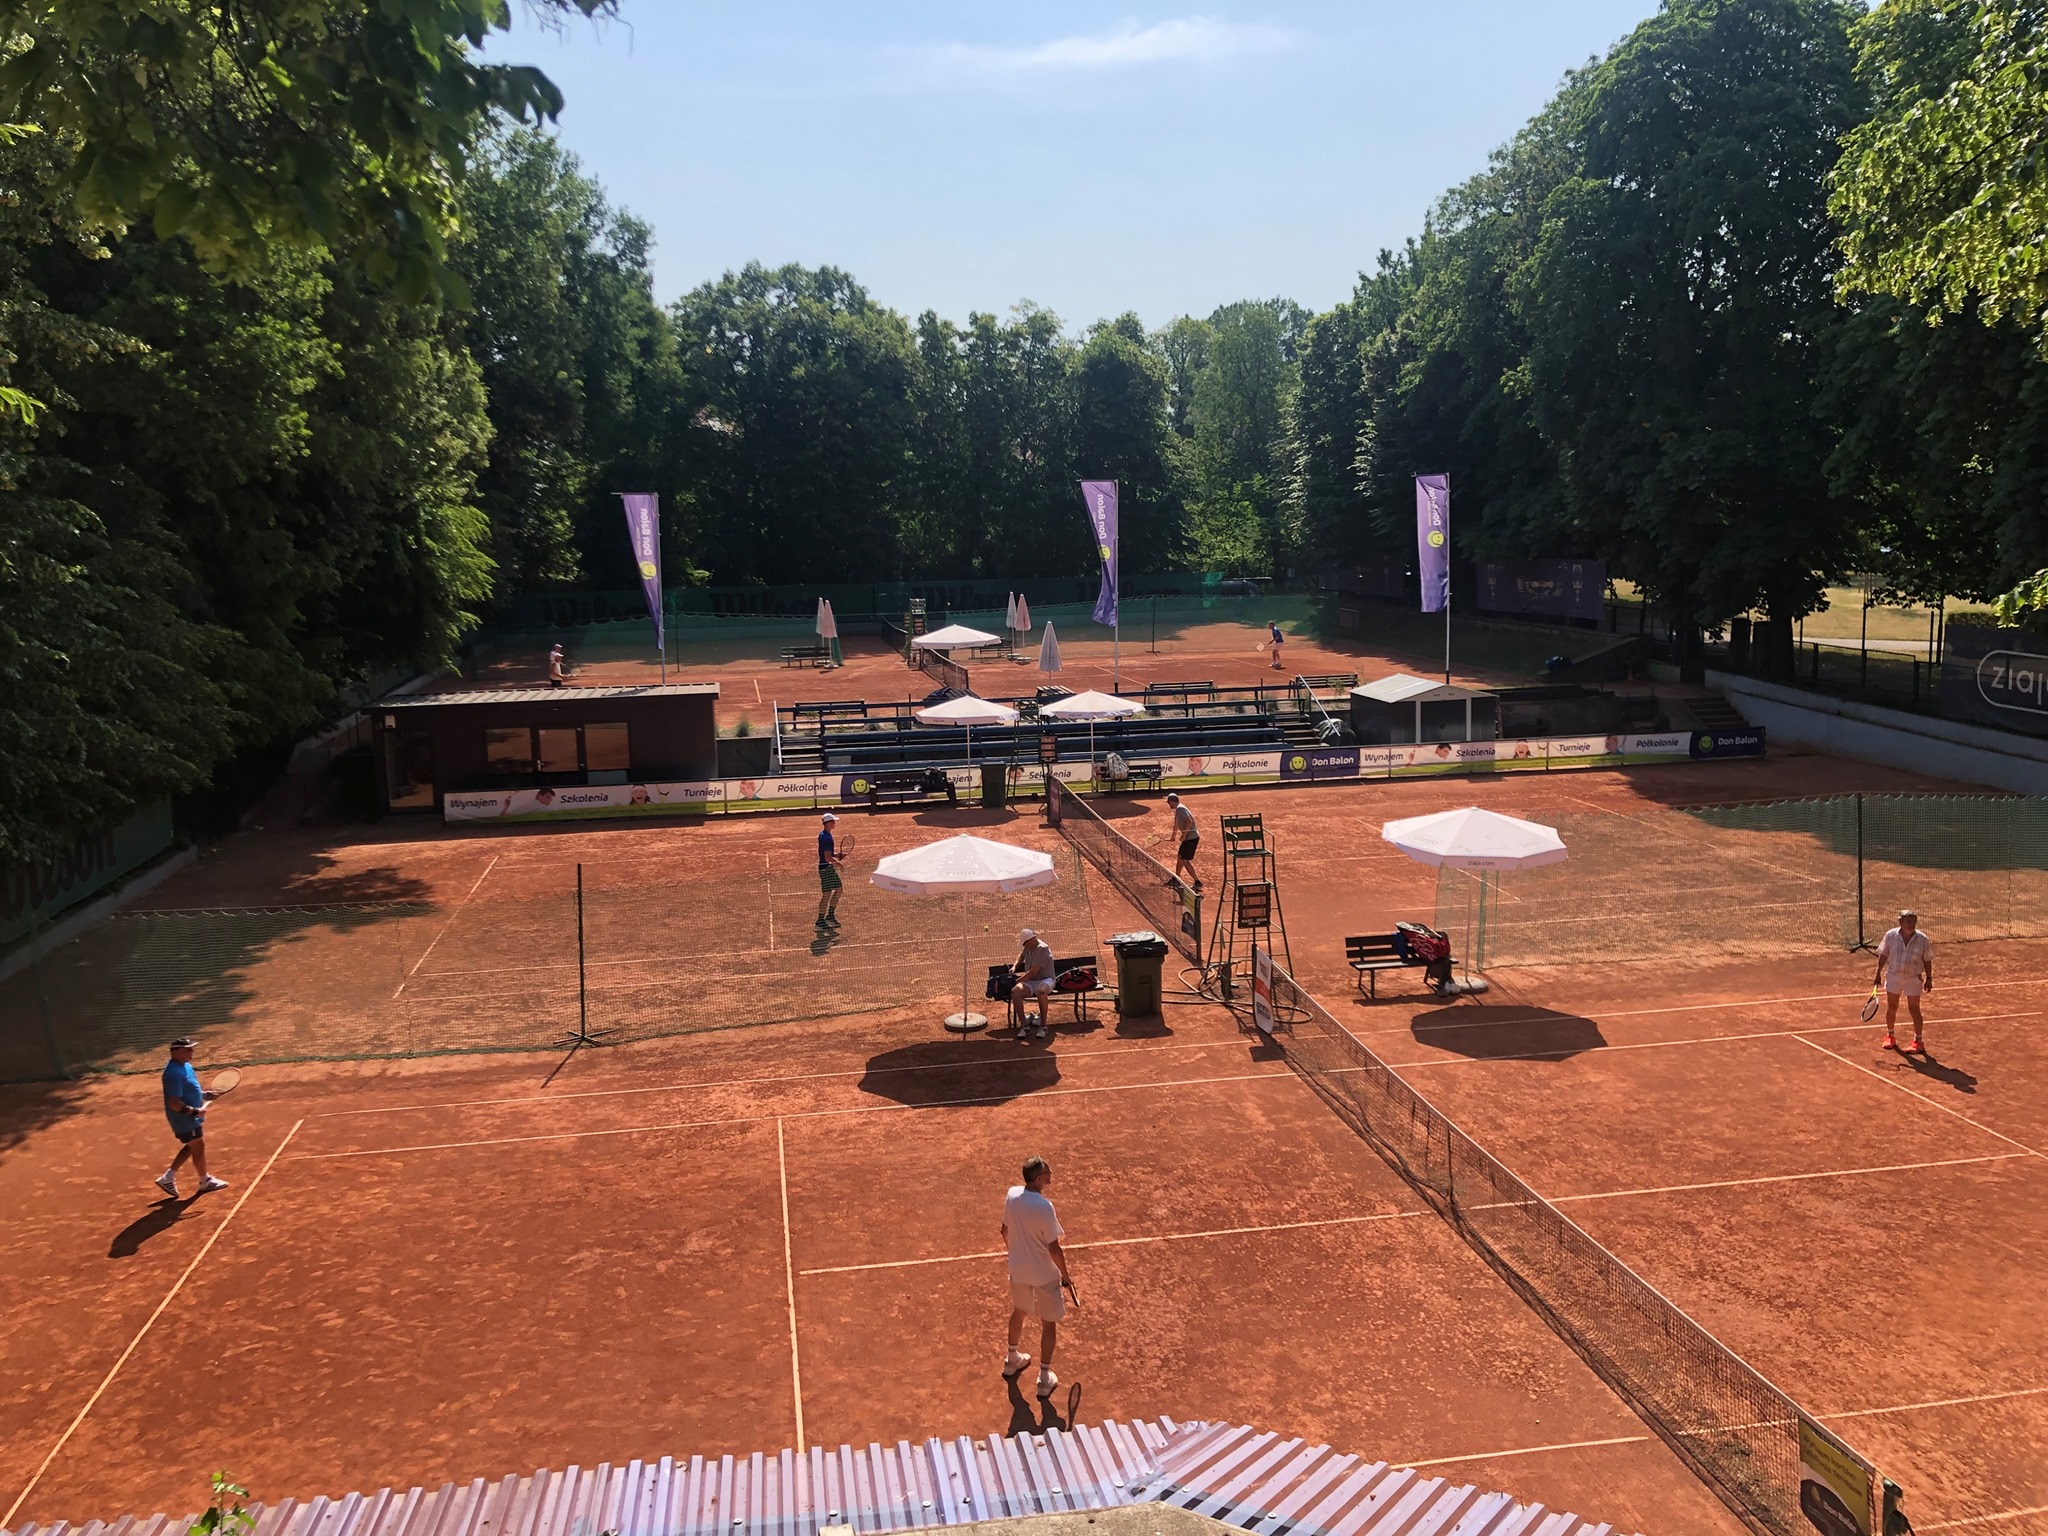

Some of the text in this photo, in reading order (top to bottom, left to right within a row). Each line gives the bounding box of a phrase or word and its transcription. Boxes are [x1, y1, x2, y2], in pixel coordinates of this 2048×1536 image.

[1991, 666, 2048, 705] ziaj
[1636, 738, 1679, 748] Półkolonie
[1718, 736, 1758, 745] Don Balon
[1456, 748, 1496, 757] Szkolenia
[1558, 742, 1591, 753] Turnieje
[1312, 756, 1354, 767] Don Balon
[1364, 752, 1404, 763] Wynajem
[777, 782, 828, 793] Półkolonie
[560, 793, 609, 804] Szkolenia
[683, 788, 722, 799] Turnieje
[450, 799, 498, 810] Wynajem
